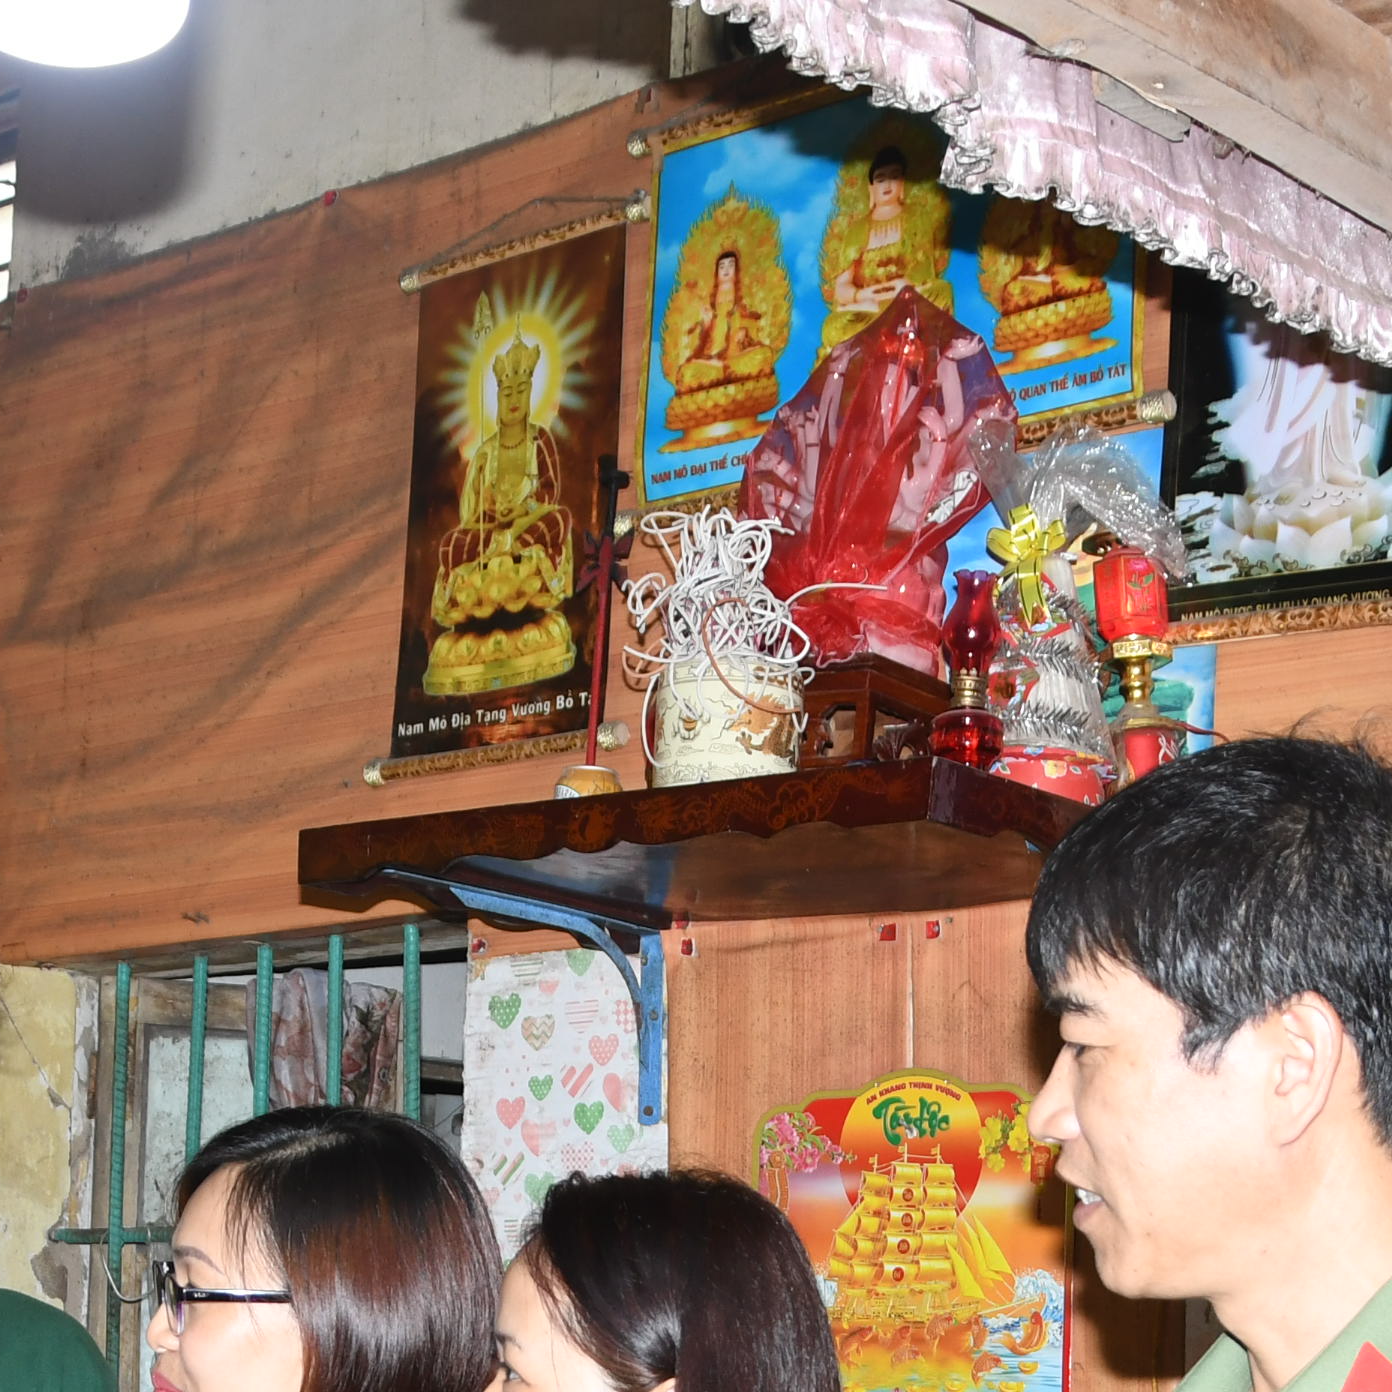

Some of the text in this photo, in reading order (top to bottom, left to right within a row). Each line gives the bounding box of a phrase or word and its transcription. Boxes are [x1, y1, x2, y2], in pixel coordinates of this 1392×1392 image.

[398, 722, 424, 737] Nam
[451, 711, 471, 730] Địa
[476, 707, 507, 724] Tạng
[879, 1082, 907, 1097] KHANG
